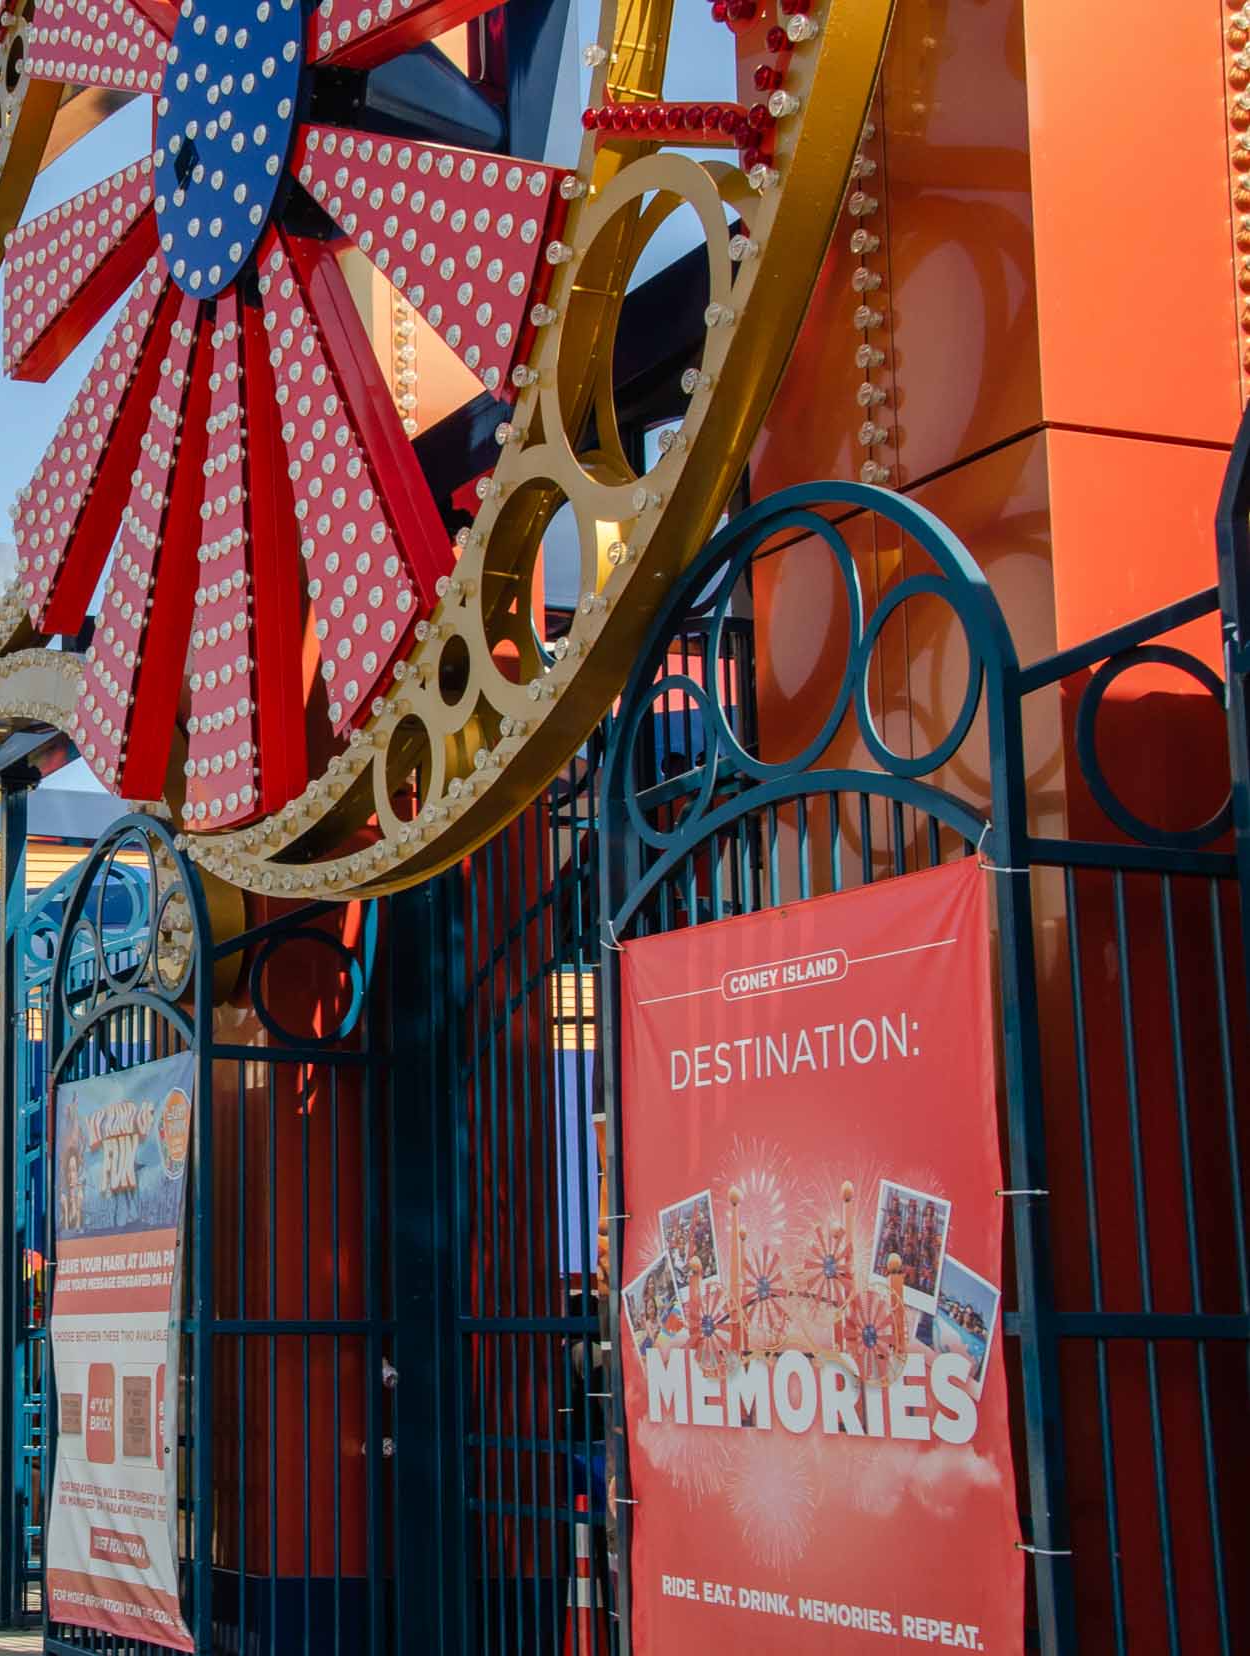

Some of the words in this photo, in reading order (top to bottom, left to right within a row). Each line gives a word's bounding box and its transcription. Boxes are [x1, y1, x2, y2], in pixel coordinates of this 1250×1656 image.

[729, 970, 779, 994] CONEY
[782, 956, 839, 985] ISLAND
[670, 1012, 920, 1091] DESTINATION:
[105, 1101, 137, 1139] KIND
[137, 1098, 155, 1138] OF
[100, 1135, 138, 1196] FUN
[79, 1256, 102, 1273] YOUR
[102, 1254, 126, 1272] MARK
[127, 1252, 138, 1269] AT
[138, 1250, 162, 1268] LUNA
[645, 1347, 979, 1445] MEMORIES
[90, 1415, 111, 1432] BRICK
[53, 1588, 67, 1601] FOR
[67, 1591, 84, 1604] MORE
[125, 1602, 142, 1617] SCAN
[661, 1574, 700, 1601] RIDE.
[703, 1582, 736, 1607] EAT.
[738, 1587, 795, 1618] DRINK.
[798, 1597, 898, 1636] MEMORIES.
[901, 1615, 985, 1651] REPEAT.
